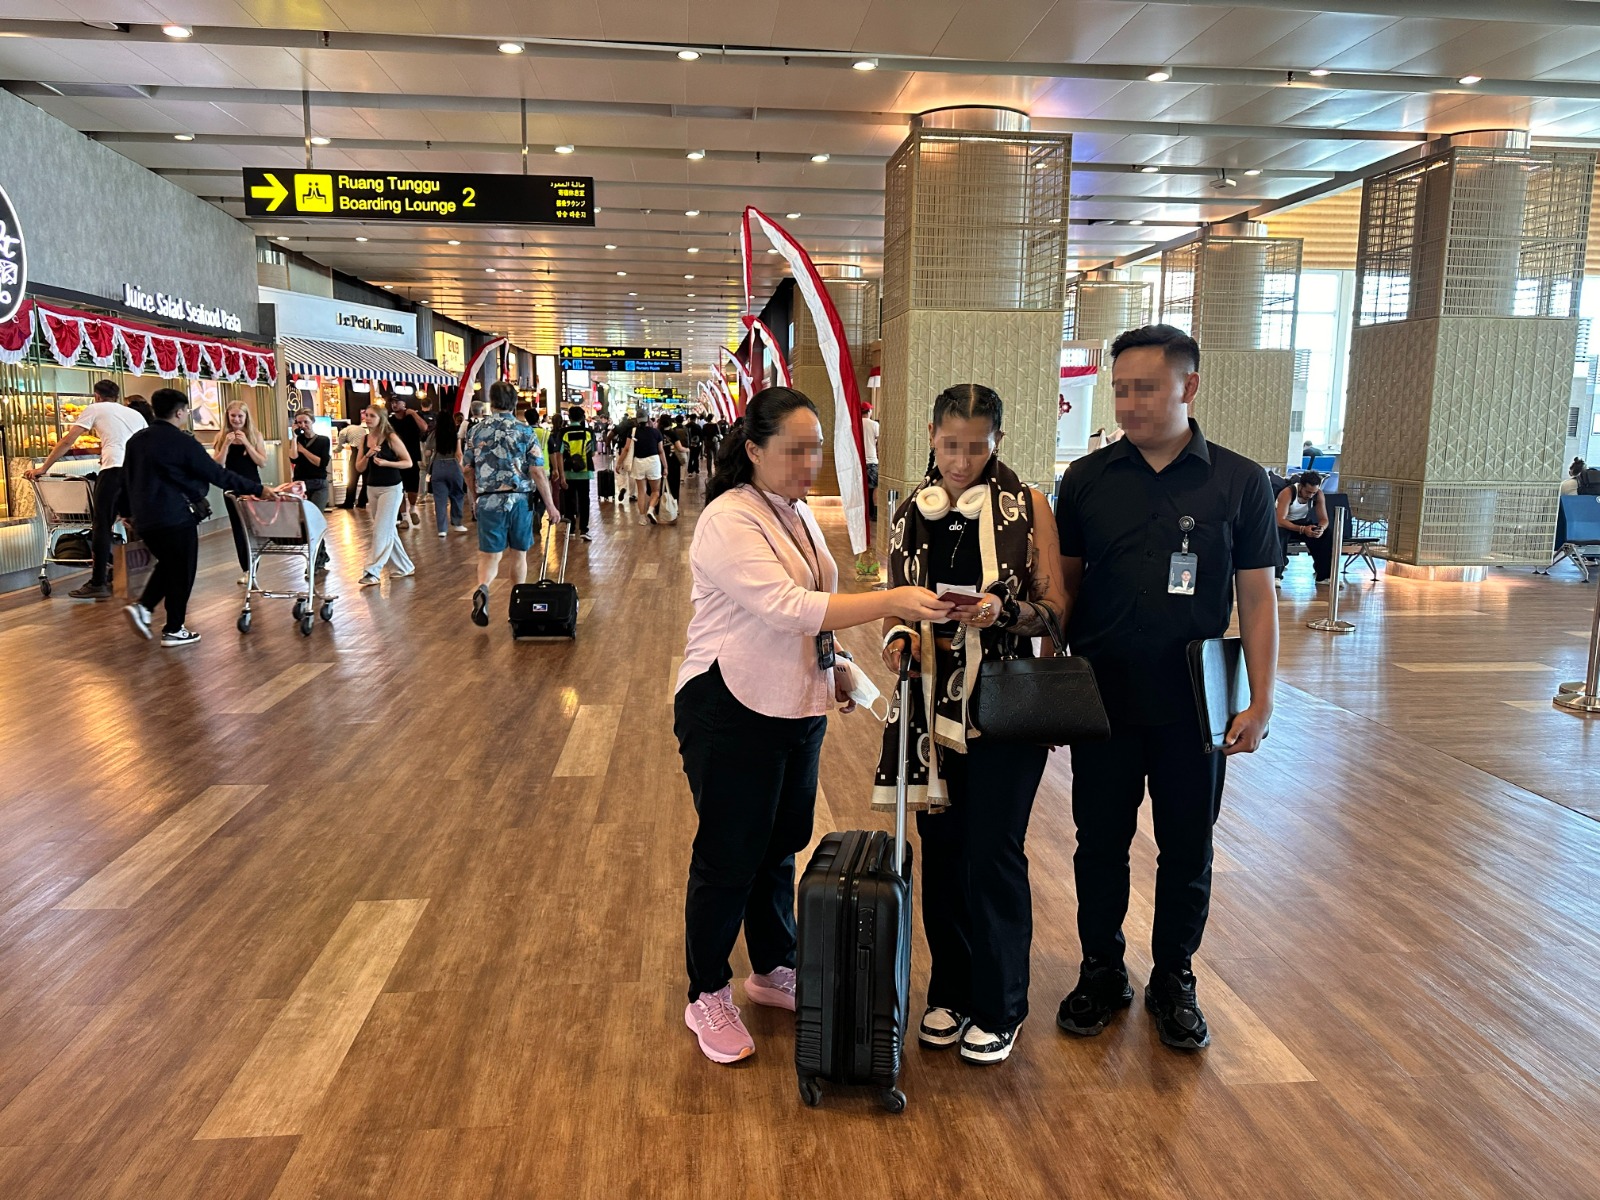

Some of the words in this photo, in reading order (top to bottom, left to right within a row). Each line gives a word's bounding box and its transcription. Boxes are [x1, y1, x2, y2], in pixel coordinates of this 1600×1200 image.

[338, 175, 384, 192] Ruang
[387, 176, 440, 194] Tunggu
[339, 196, 402, 214] Boarding
[404, 198, 456, 215] Lounge
[462, 187, 476, 207] 2
[220, 309, 242, 333] Pasta
[350, 315, 372, 330] Petit
[949, 520, 963, 531] alo
